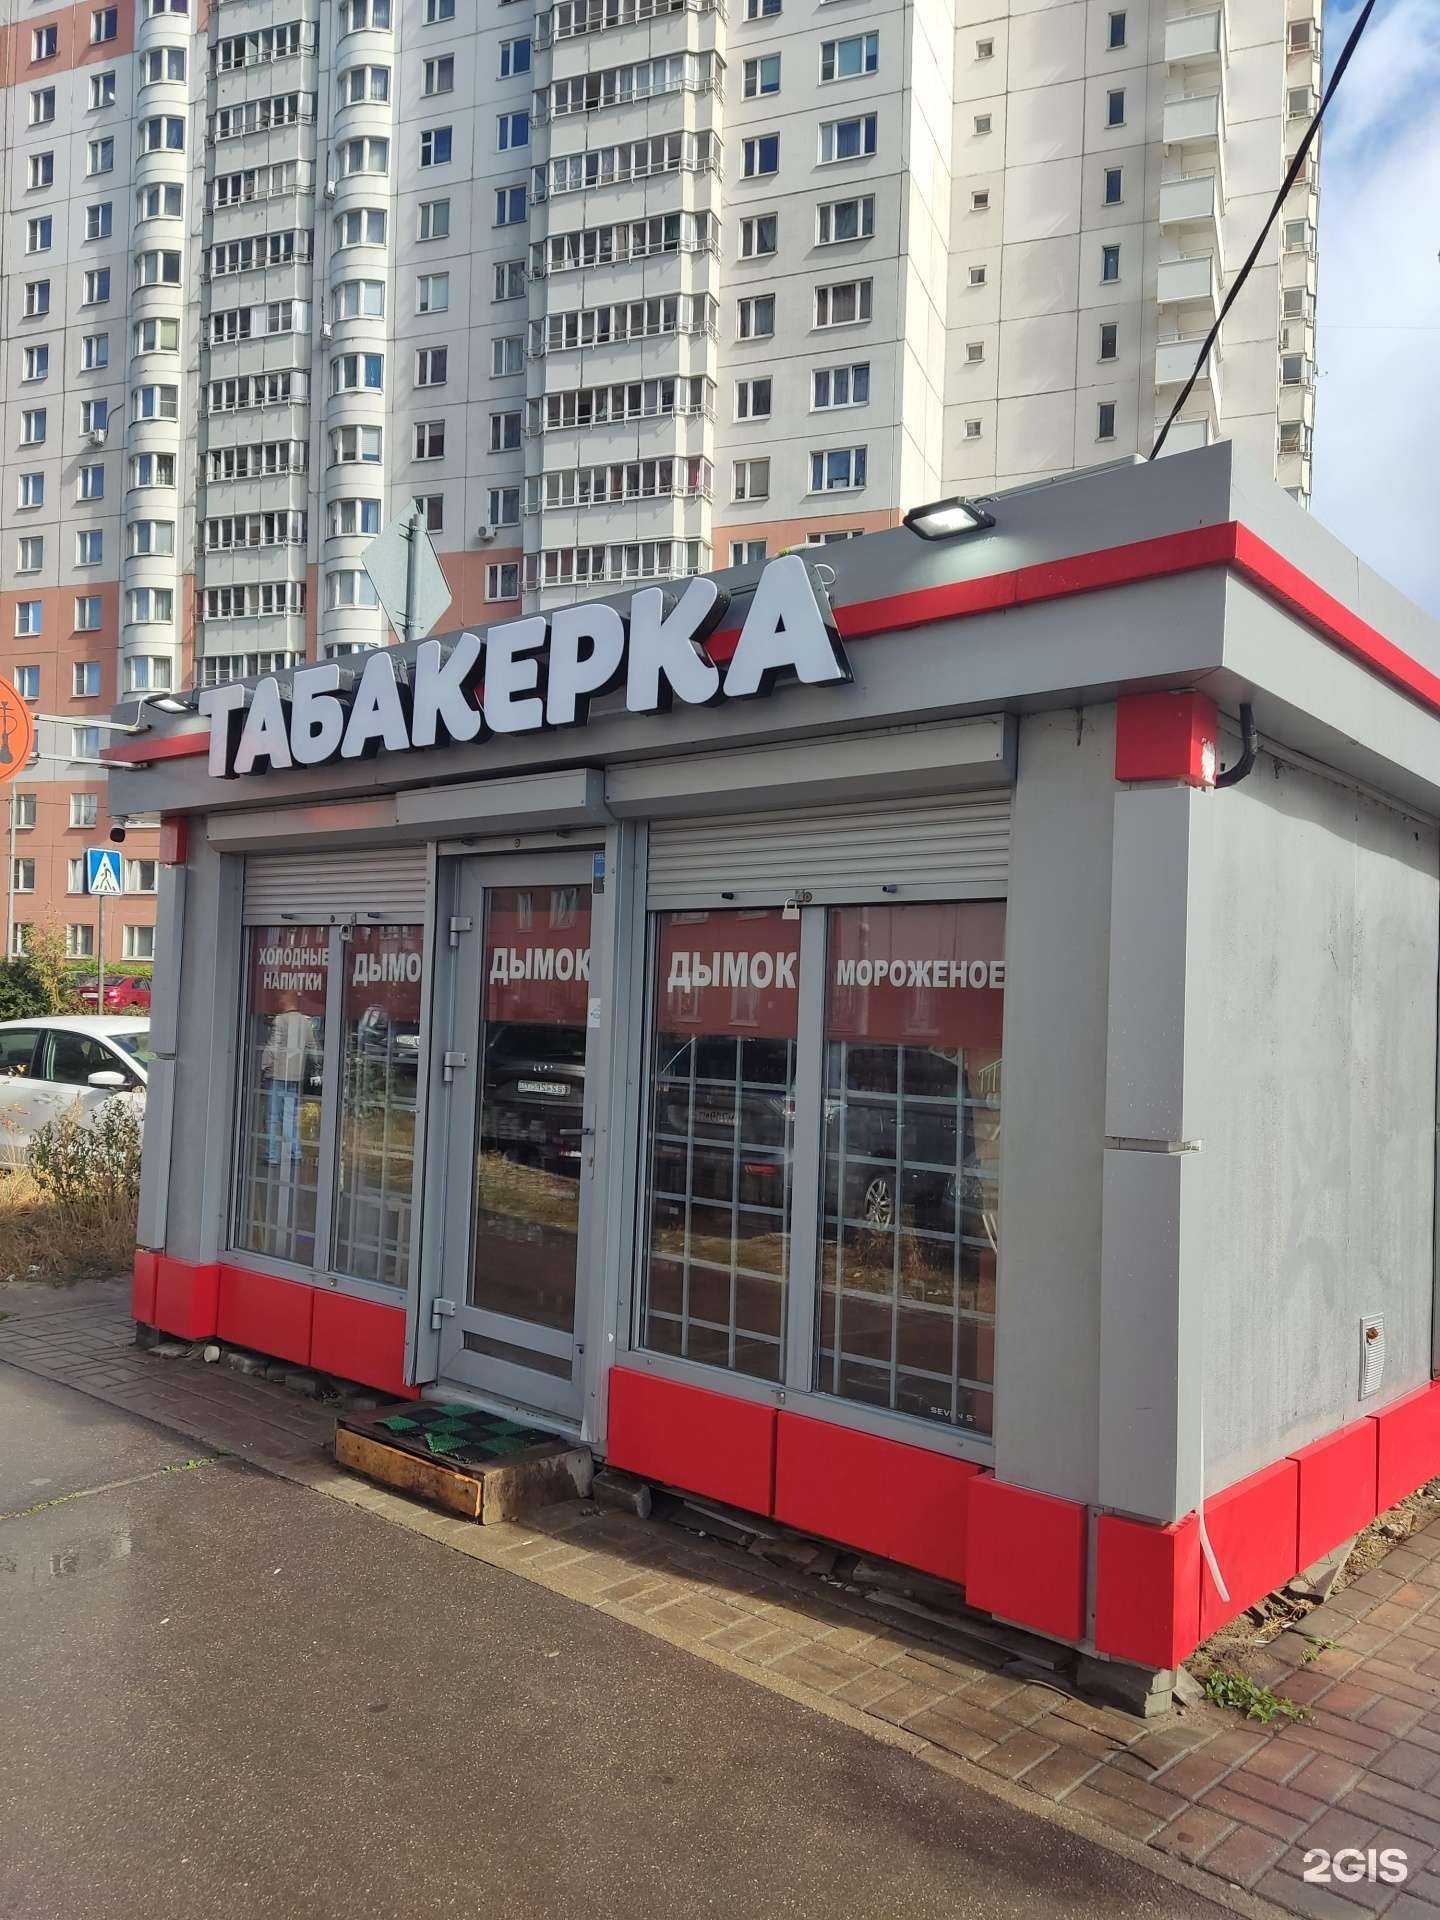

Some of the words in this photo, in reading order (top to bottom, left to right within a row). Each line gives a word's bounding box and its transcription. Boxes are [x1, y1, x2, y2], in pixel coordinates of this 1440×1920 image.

[198, 554, 846, 778] ТАБАКЕРКА
[258, 947, 329, 968] ХОЛОДНЫЕ
[489, 947, 591, 985] ДЫМОК
[667, 951, 798, 993] ДЫМОК
[836, 959, 1007, 989] МОРОЖЕНОЕ
[263, 972, 322, 991] НАПИТКИ
